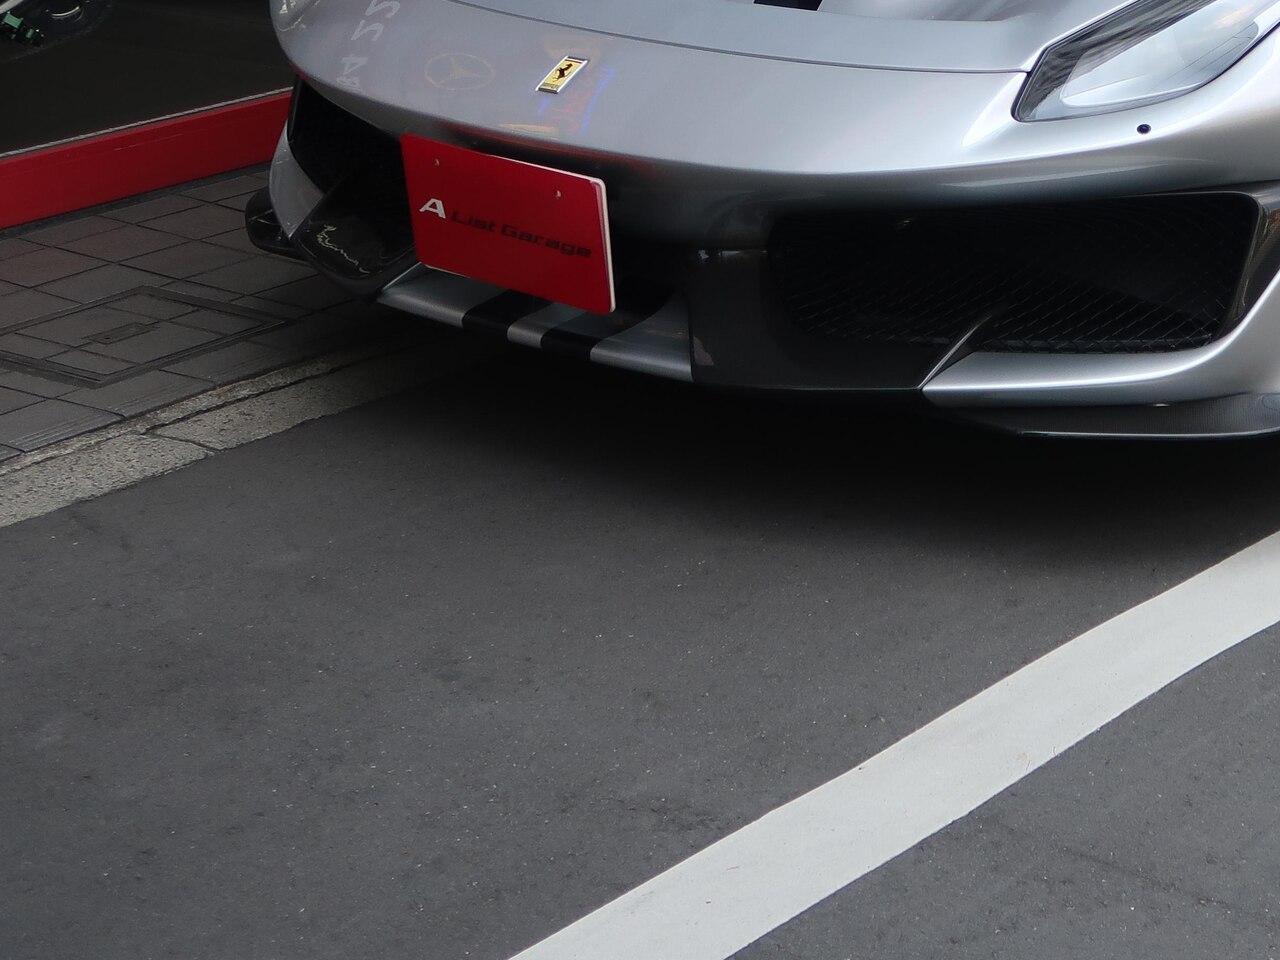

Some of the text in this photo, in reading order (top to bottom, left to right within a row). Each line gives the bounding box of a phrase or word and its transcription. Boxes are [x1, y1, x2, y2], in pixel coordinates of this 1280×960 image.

[419, 198, 592, 258] A List Garage
